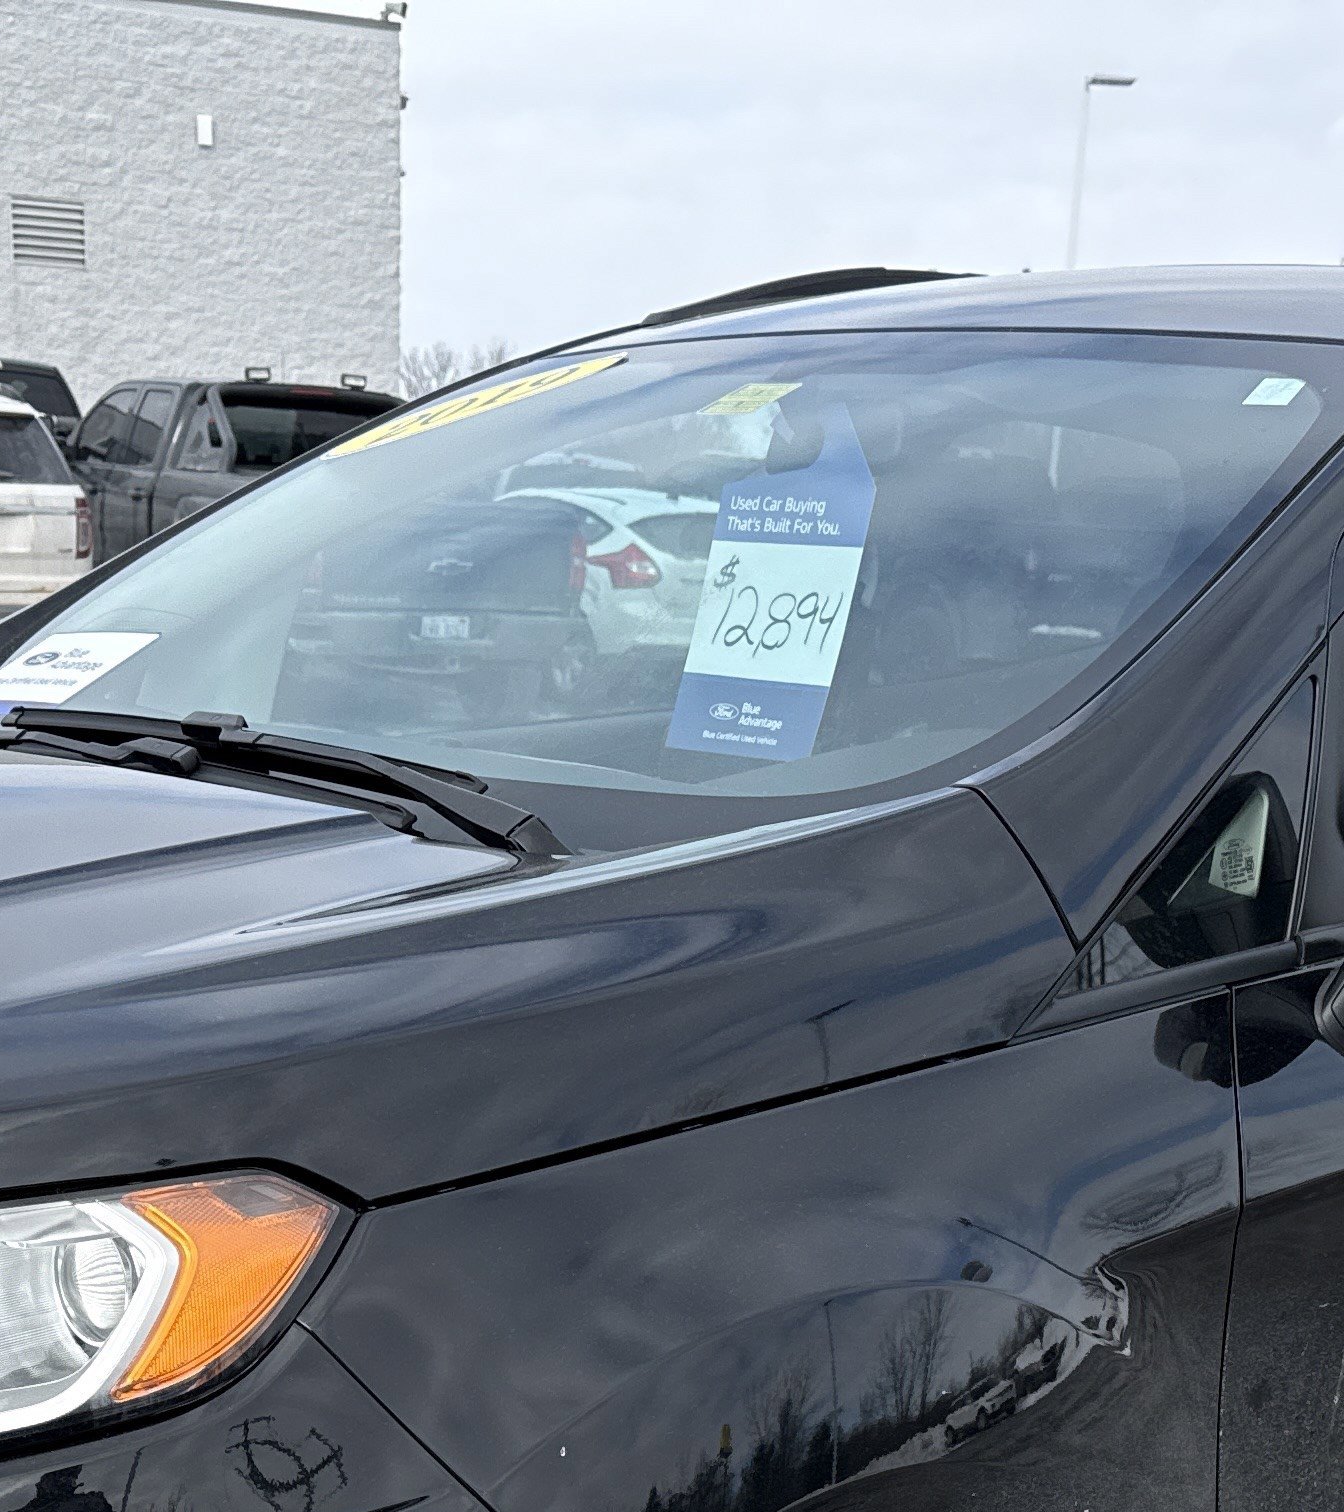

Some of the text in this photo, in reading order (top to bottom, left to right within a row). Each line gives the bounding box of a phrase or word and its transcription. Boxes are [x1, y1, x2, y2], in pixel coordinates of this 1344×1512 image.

[364, 365, 582, 447] 2019
[730, 495, 827, 517] Used Car Buying
[727, 515, 841, 536] That's Built For You.
[712, 554, 741, 592] $
[711, 585, 844, 658] 12,894
[741, 701, 762, 715] Blue
[737, 714, 783, 732] Advantage
